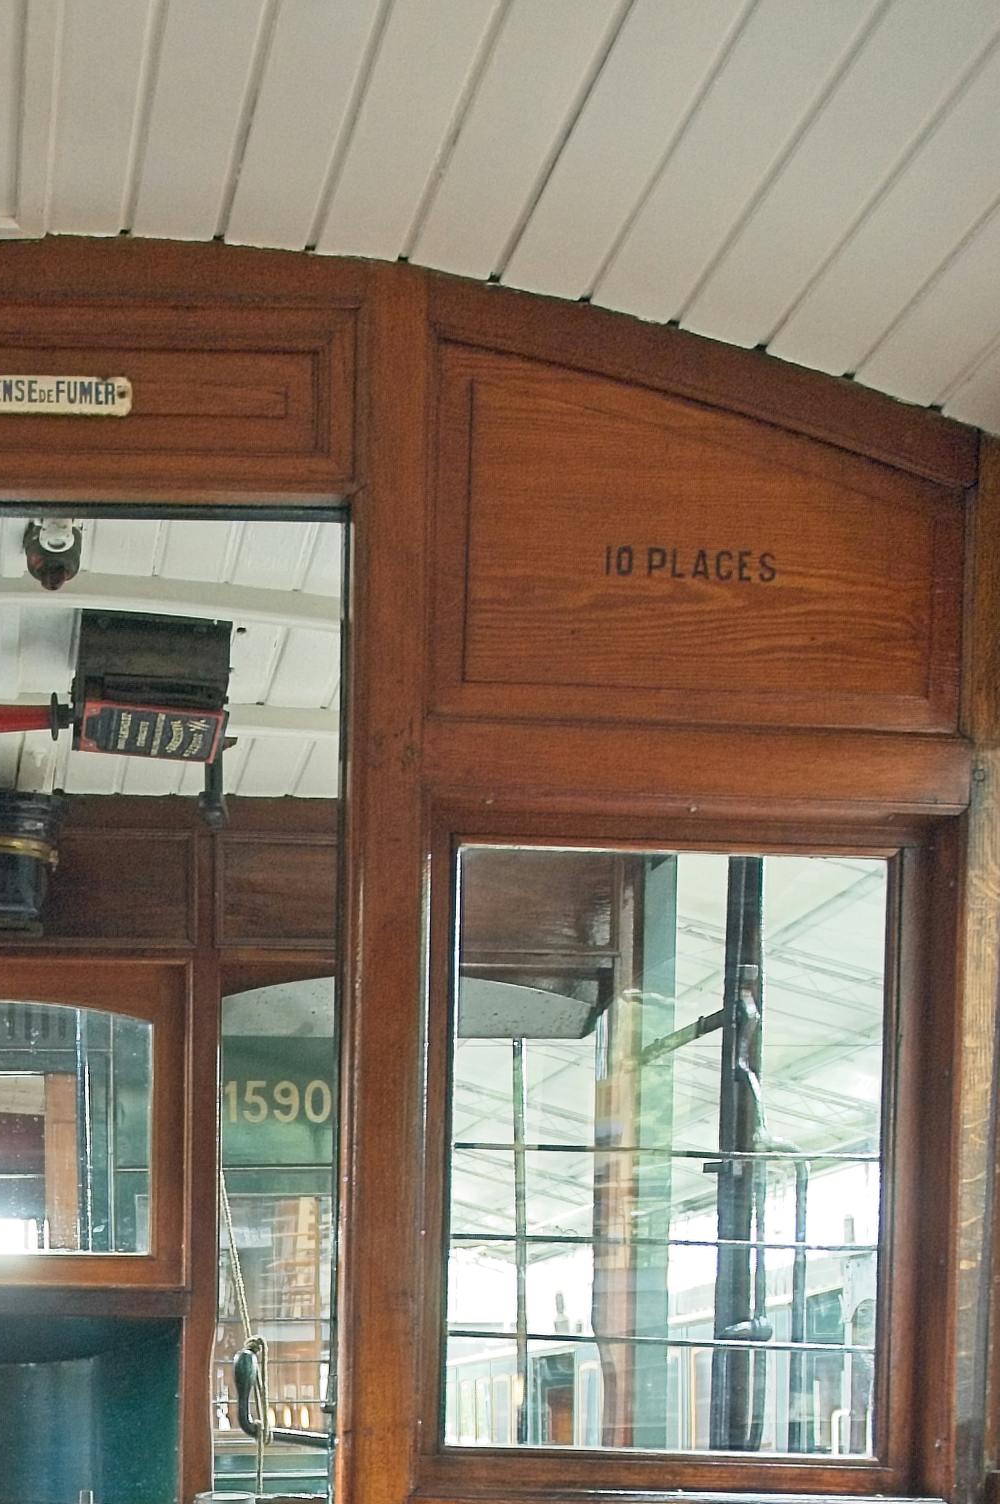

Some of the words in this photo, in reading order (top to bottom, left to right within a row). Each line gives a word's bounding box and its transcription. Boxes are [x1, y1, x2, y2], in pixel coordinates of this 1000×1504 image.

[38, 388, 54, 403] DE
[55, 380, 116, 405] FUMER
[604, 545, 633, 577] 10
[646, 547, 777, 583] PLACES
[224, 1079, 332, 1124] 1590
